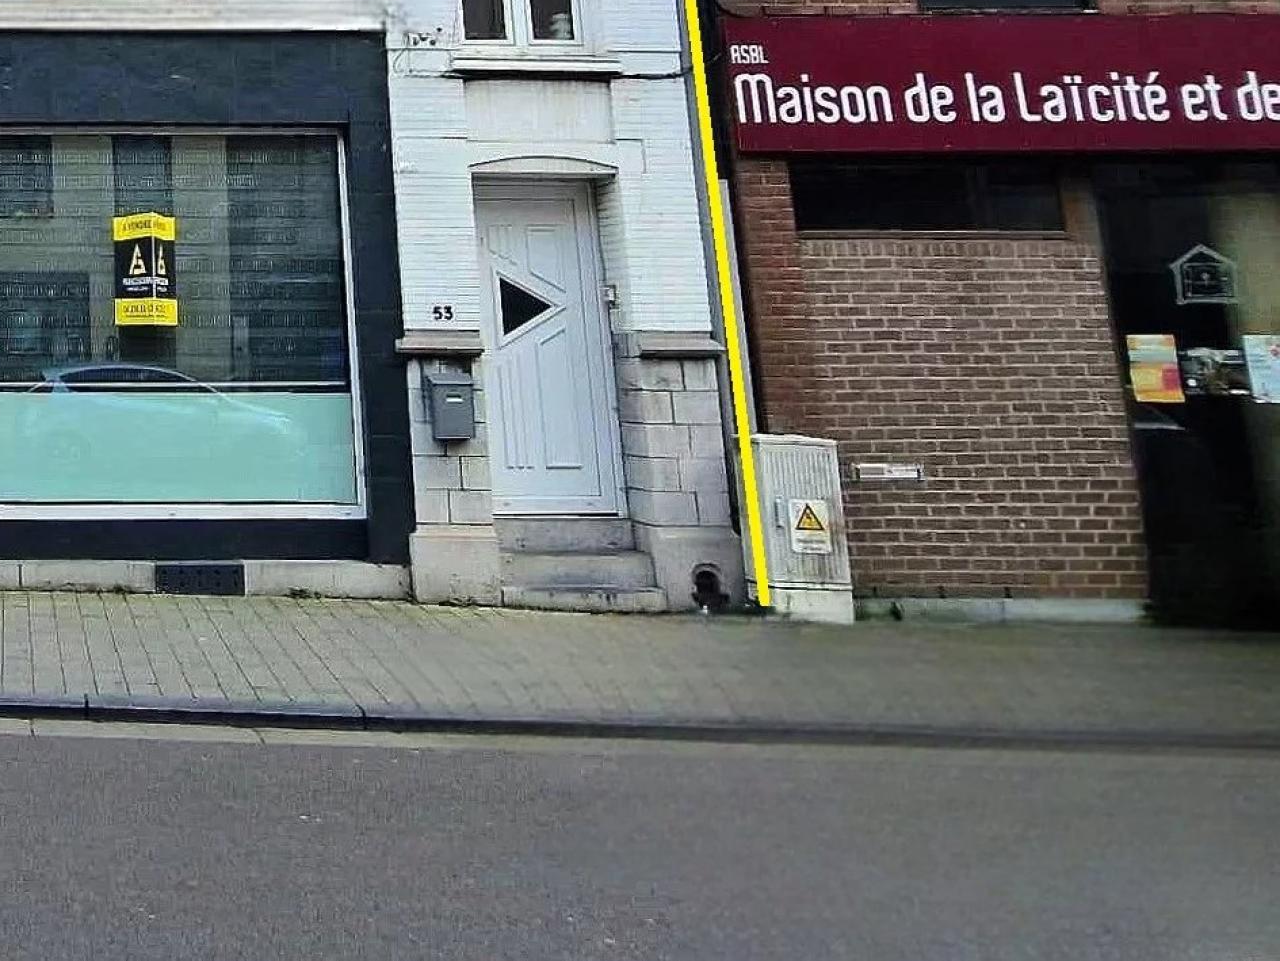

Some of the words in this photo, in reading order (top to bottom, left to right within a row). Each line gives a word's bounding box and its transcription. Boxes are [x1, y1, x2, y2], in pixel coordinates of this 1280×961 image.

[730, 44, 769, 64] ASBL
[734, 73, 894, 123] Maison
[904, 72, 957, 122] de
[965, 71, 1006, 122] la
[1013, 71, 1170, 122] Laïcité
[1181, 75, 1228, 121] et
[1237, 71, 1280, 121] de
[432, 305, 454, 321] 53
